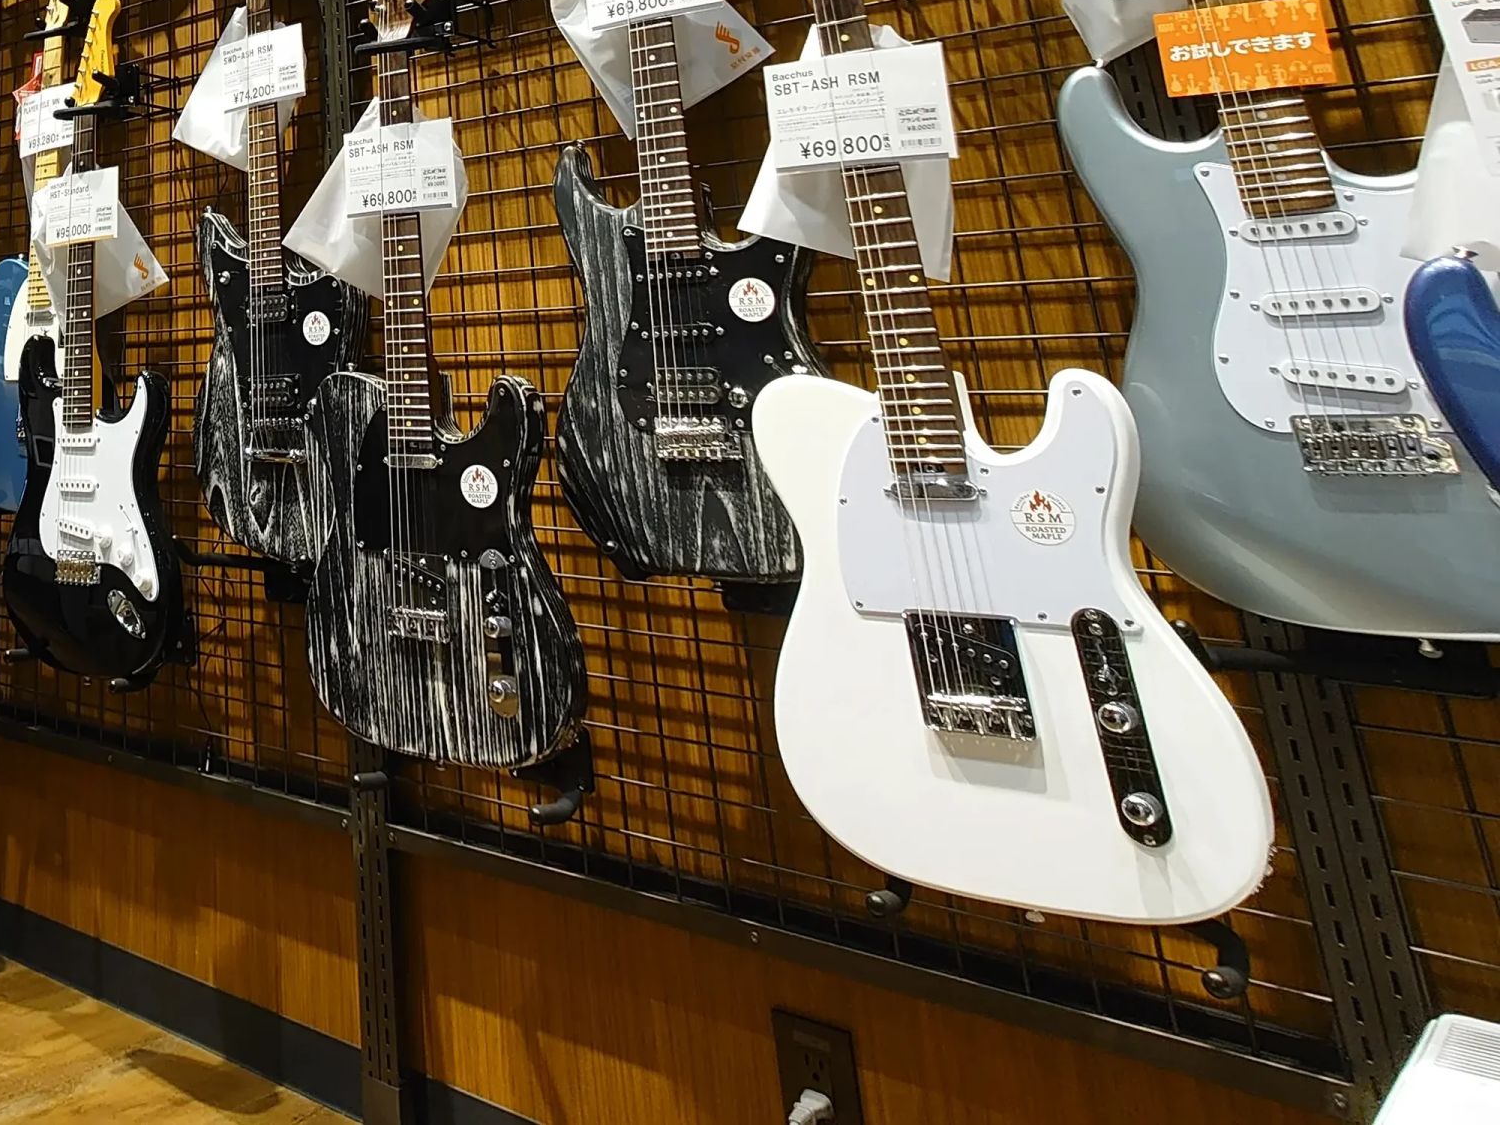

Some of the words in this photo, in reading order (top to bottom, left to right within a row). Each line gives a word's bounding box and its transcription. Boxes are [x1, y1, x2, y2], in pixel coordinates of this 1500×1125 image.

[1169, 31, 1317, 63] お試しできます
[771, 68, 814, 83] Bacchus
[774, 75, 840, 97] SBT-ASH
[848, 70, 881, 87] RSM
[348, 142, 389, 159] SBT-ASH
[393, 139, 414, 151] RSM
[799, 134, 883, 160] ¥69800
[739, 297, 766, 306] RSM
[468, 483, 490, 492] RSM
[1024, 511, 1063, 524] RSM
[1025, 526, 1067, 535] ROASTED
[1031, 532, 1063, 541] MAPLE
